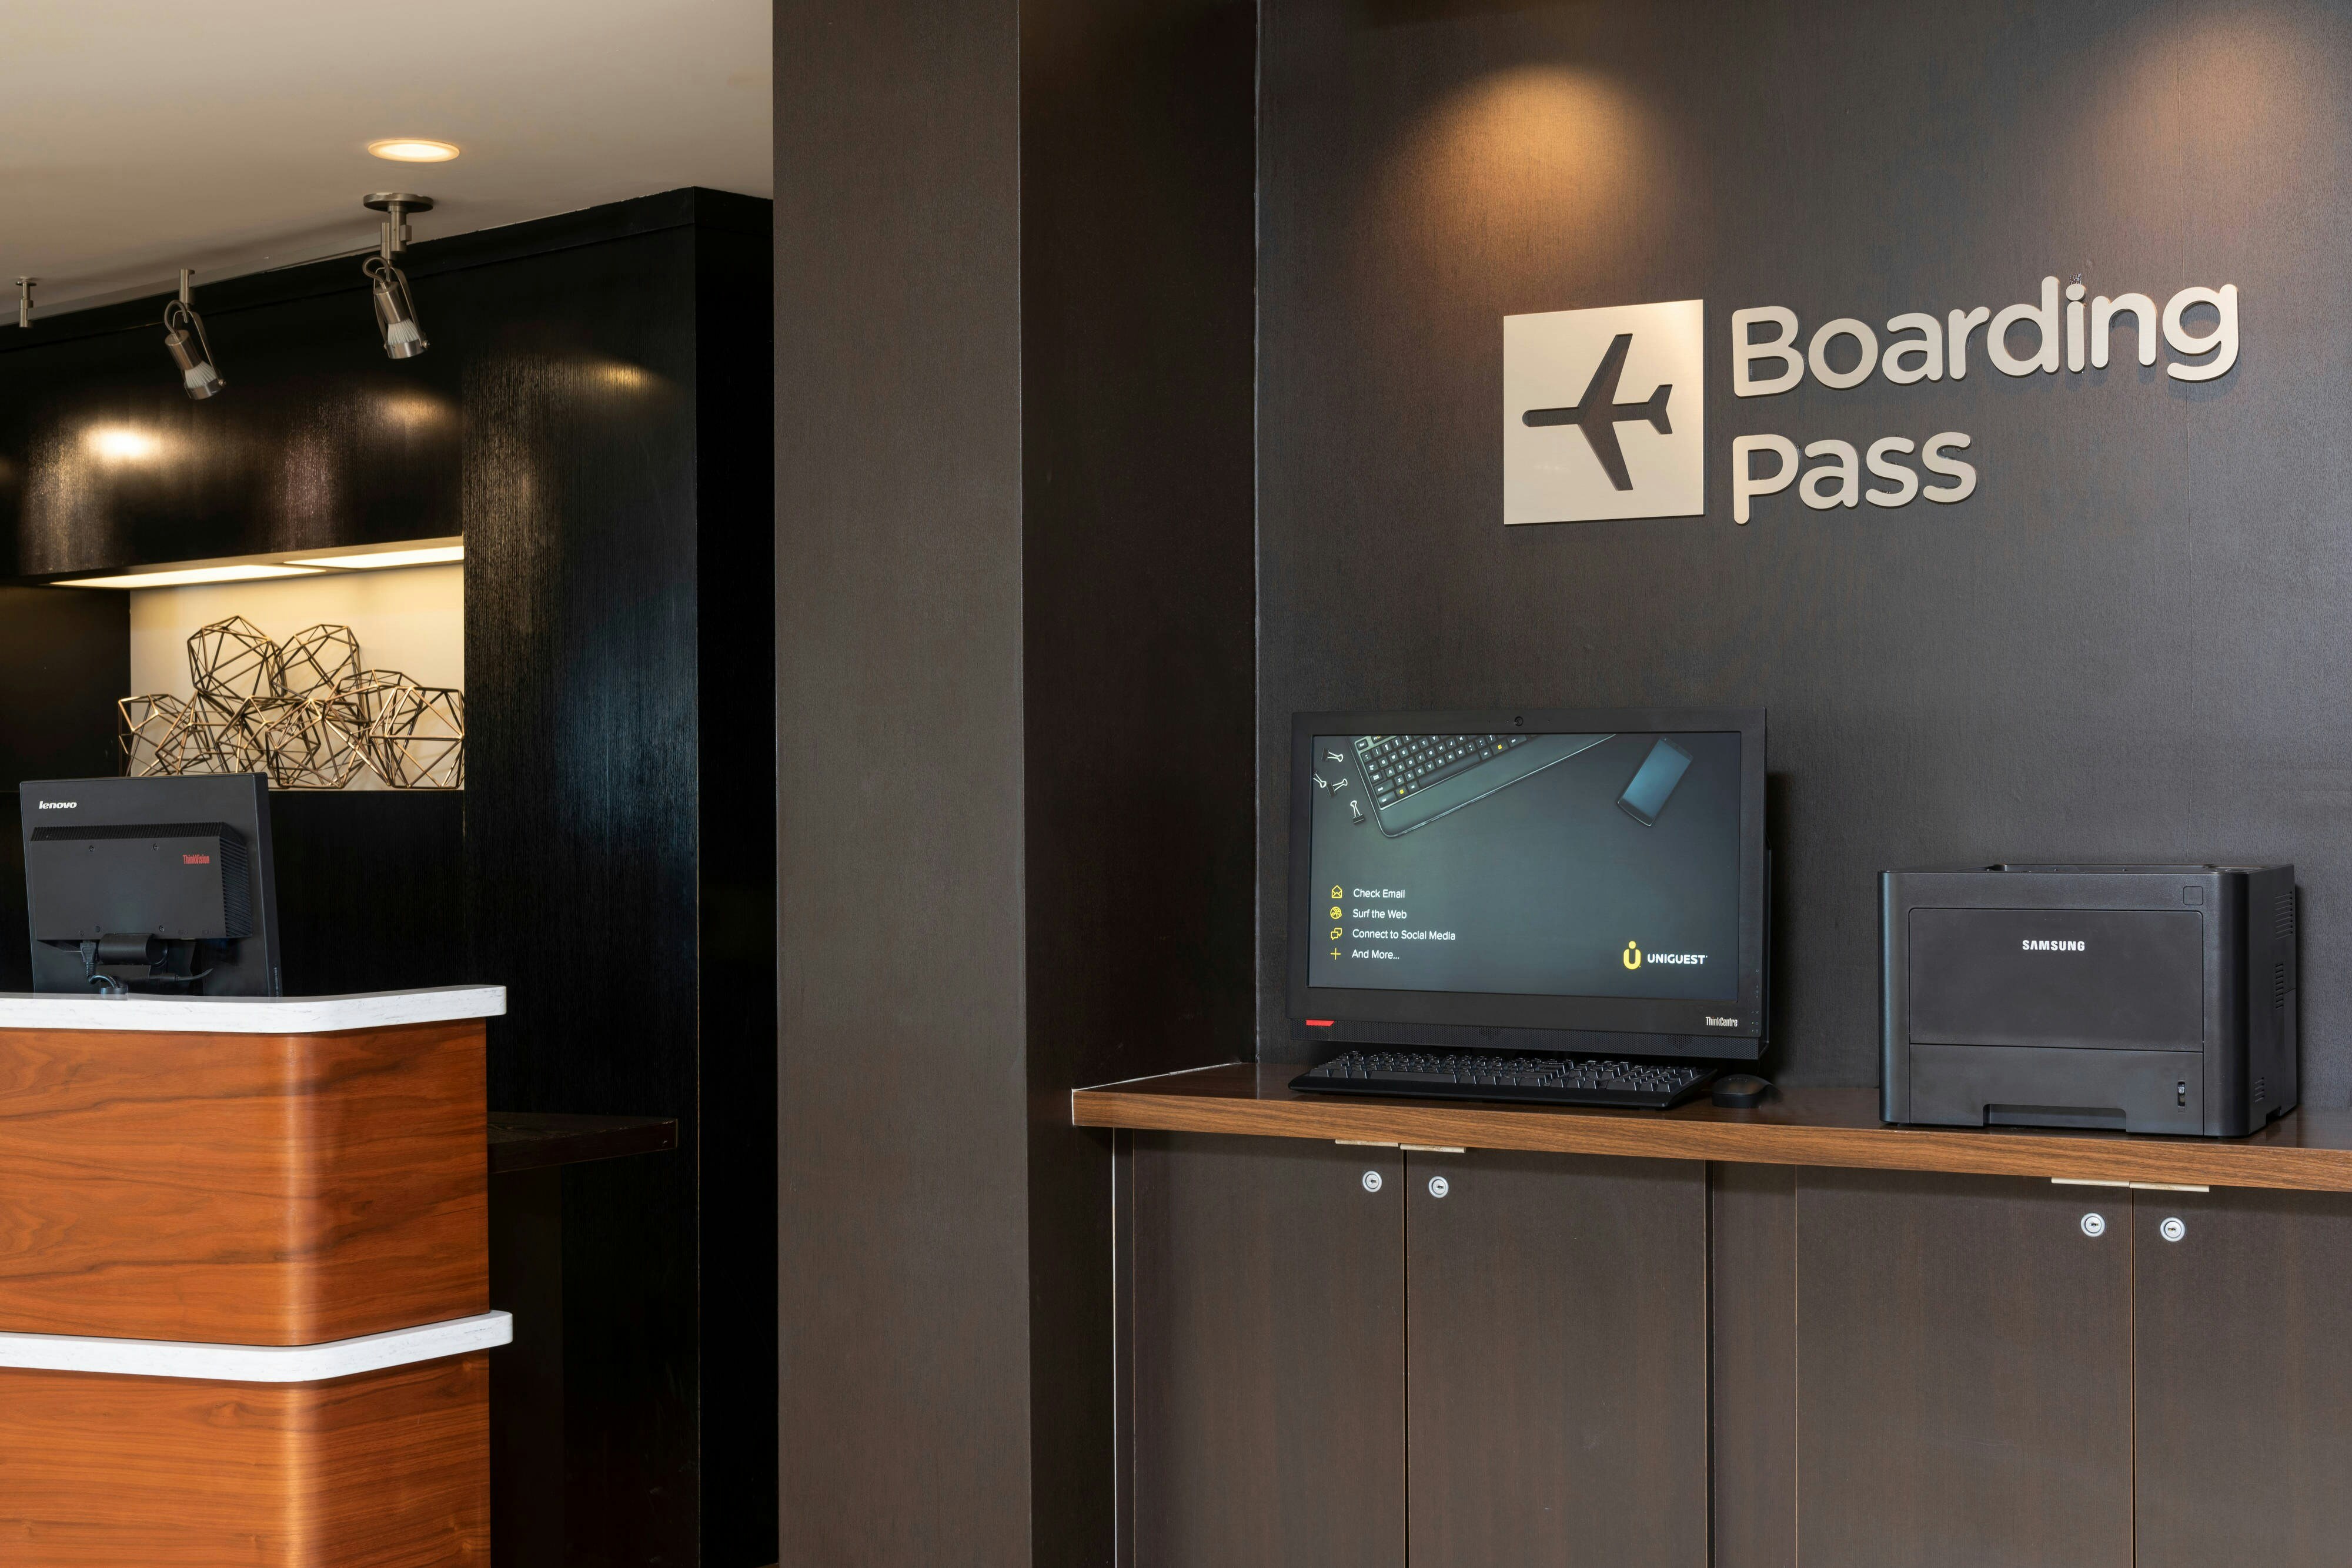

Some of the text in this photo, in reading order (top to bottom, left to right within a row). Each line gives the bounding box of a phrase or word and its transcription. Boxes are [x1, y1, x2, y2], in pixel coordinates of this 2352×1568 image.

[1732, 276, 2239, 398] Boarding
[1732, 432, 1978, 524] Pass
[39, 800, 77, 810] lenovo
[182, 854, 210, 864] ThinkVision
[1353, 888, 1405, 898] Check Email
[1352, 909, 1407, 919] Surf the Web
[1352, 929, 1456, 941] Connect to Social Media
[2022, 940, 2085, 951] SAMSUNG
[1351, 949, 1399, 959] And More...
[1647, 953, 1708, 965] UNIGUEST
[1705, 1016, 1738, 1027] ThinkCentre
